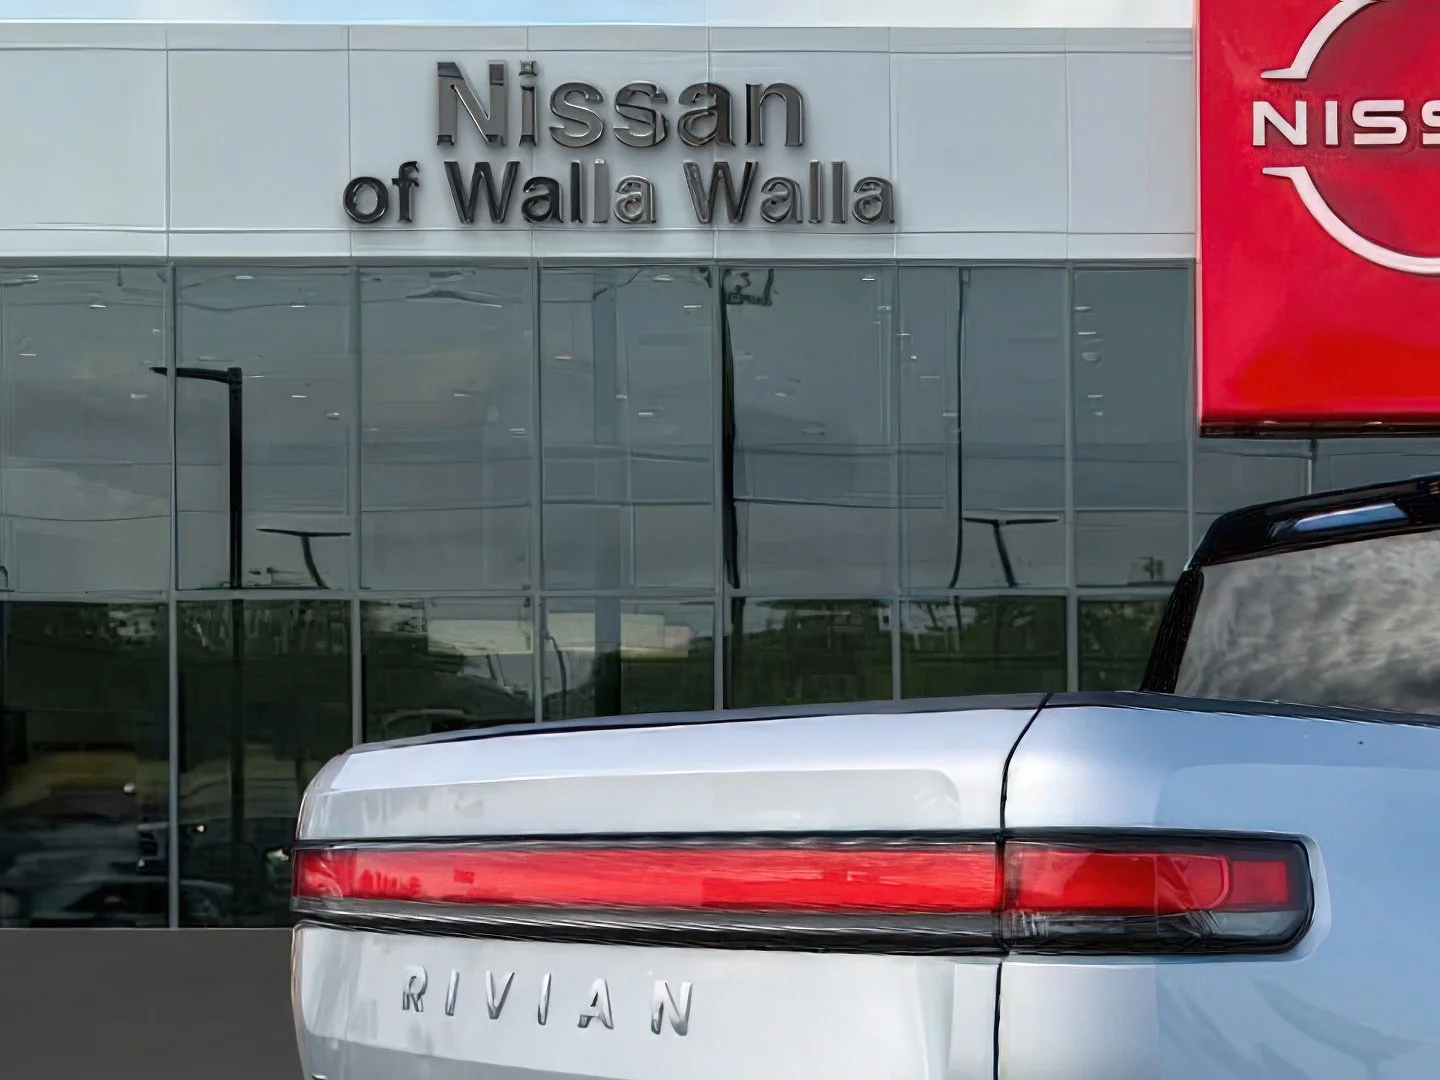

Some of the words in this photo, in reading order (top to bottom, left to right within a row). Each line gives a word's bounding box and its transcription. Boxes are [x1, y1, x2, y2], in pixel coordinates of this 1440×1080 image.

[436, 59, 806, 148] Nissan
[342, 160, 420, 224] of
[443, 159, 657, 224] Walla
[682, 159, 896, 224] Walla
[401, 964, 693, 1037] RIVIAN
